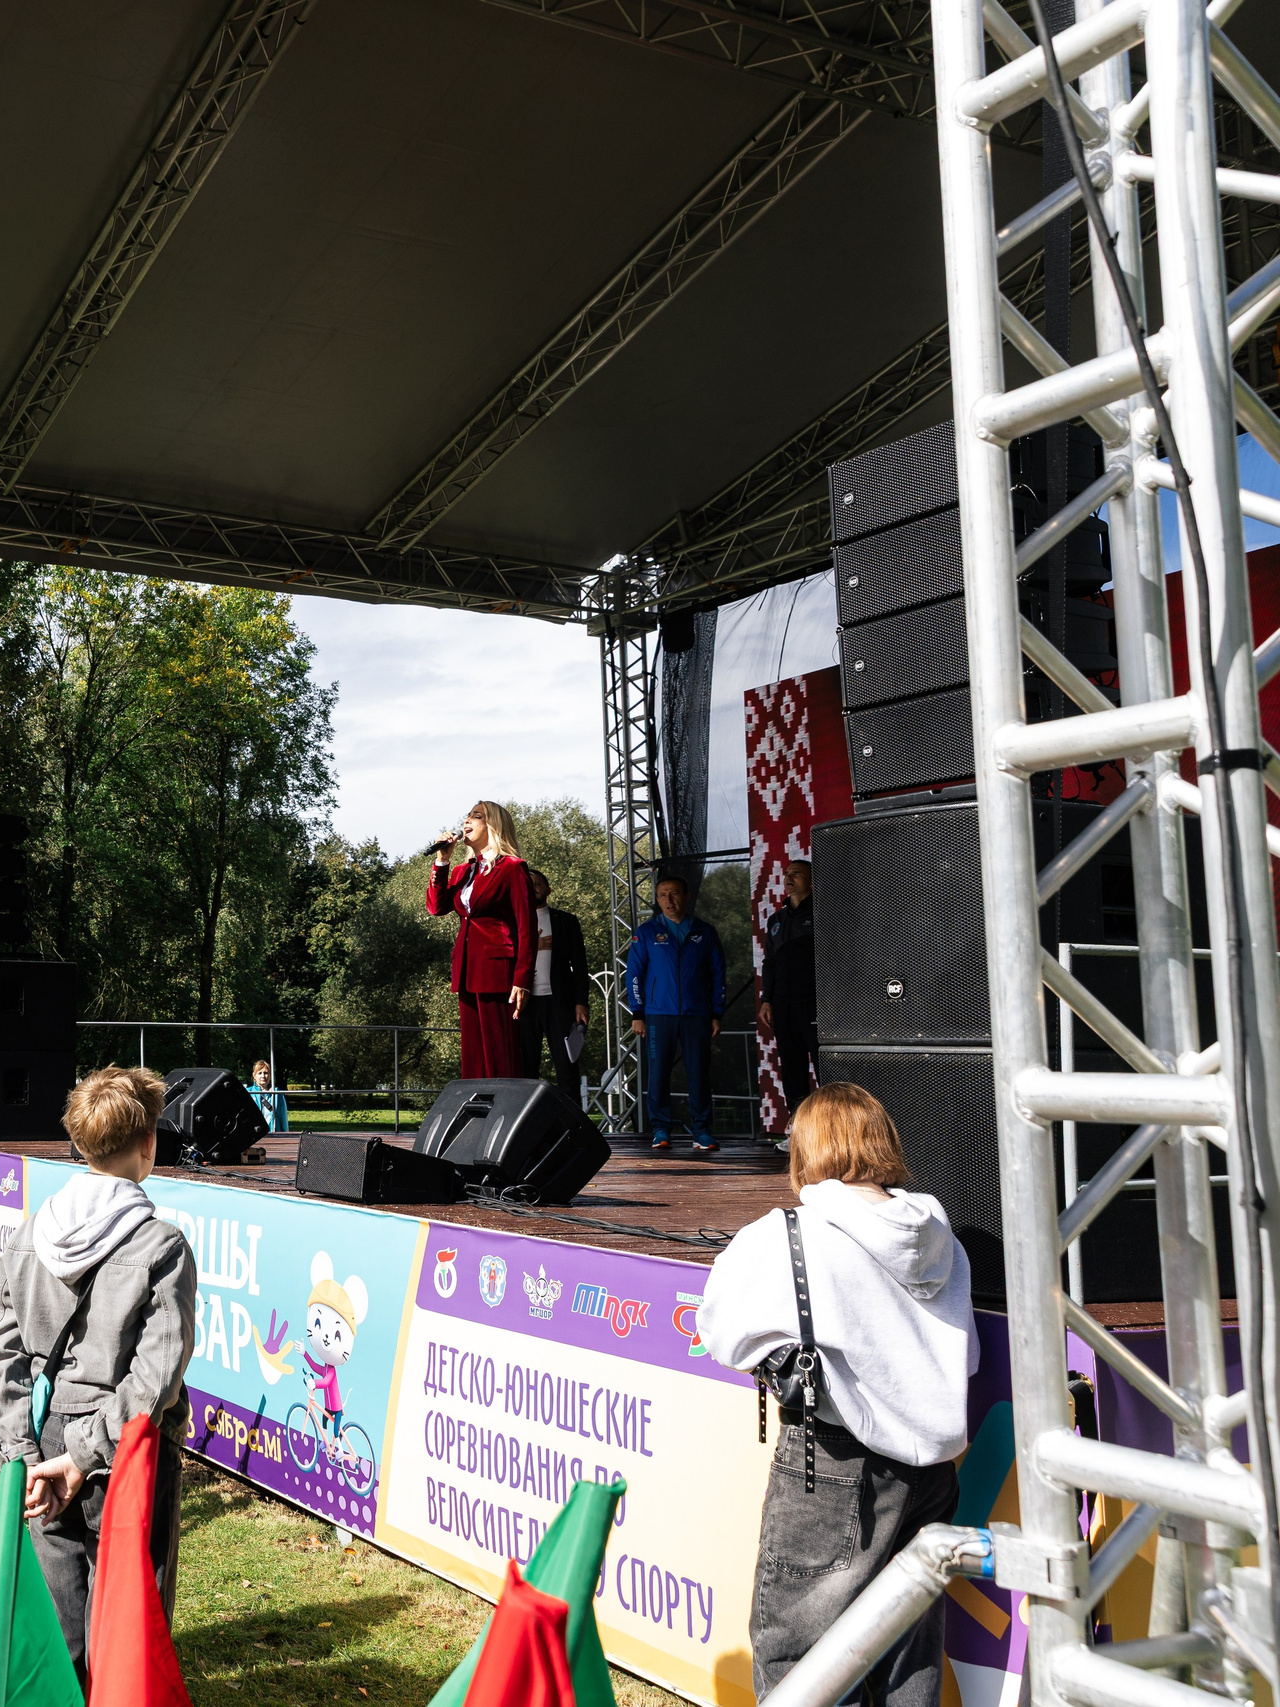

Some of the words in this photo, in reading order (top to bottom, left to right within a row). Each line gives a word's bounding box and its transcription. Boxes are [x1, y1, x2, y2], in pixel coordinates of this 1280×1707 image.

[153, 1205, 262, 1296] РШЫ
[192, 1288, 252, 1373] ВАР
[423, 1341, 653, 1457] ДЕТСКО-ЮНОШЕСКИЕ
[616, 1553, 713, 1643] СПОРТУ
